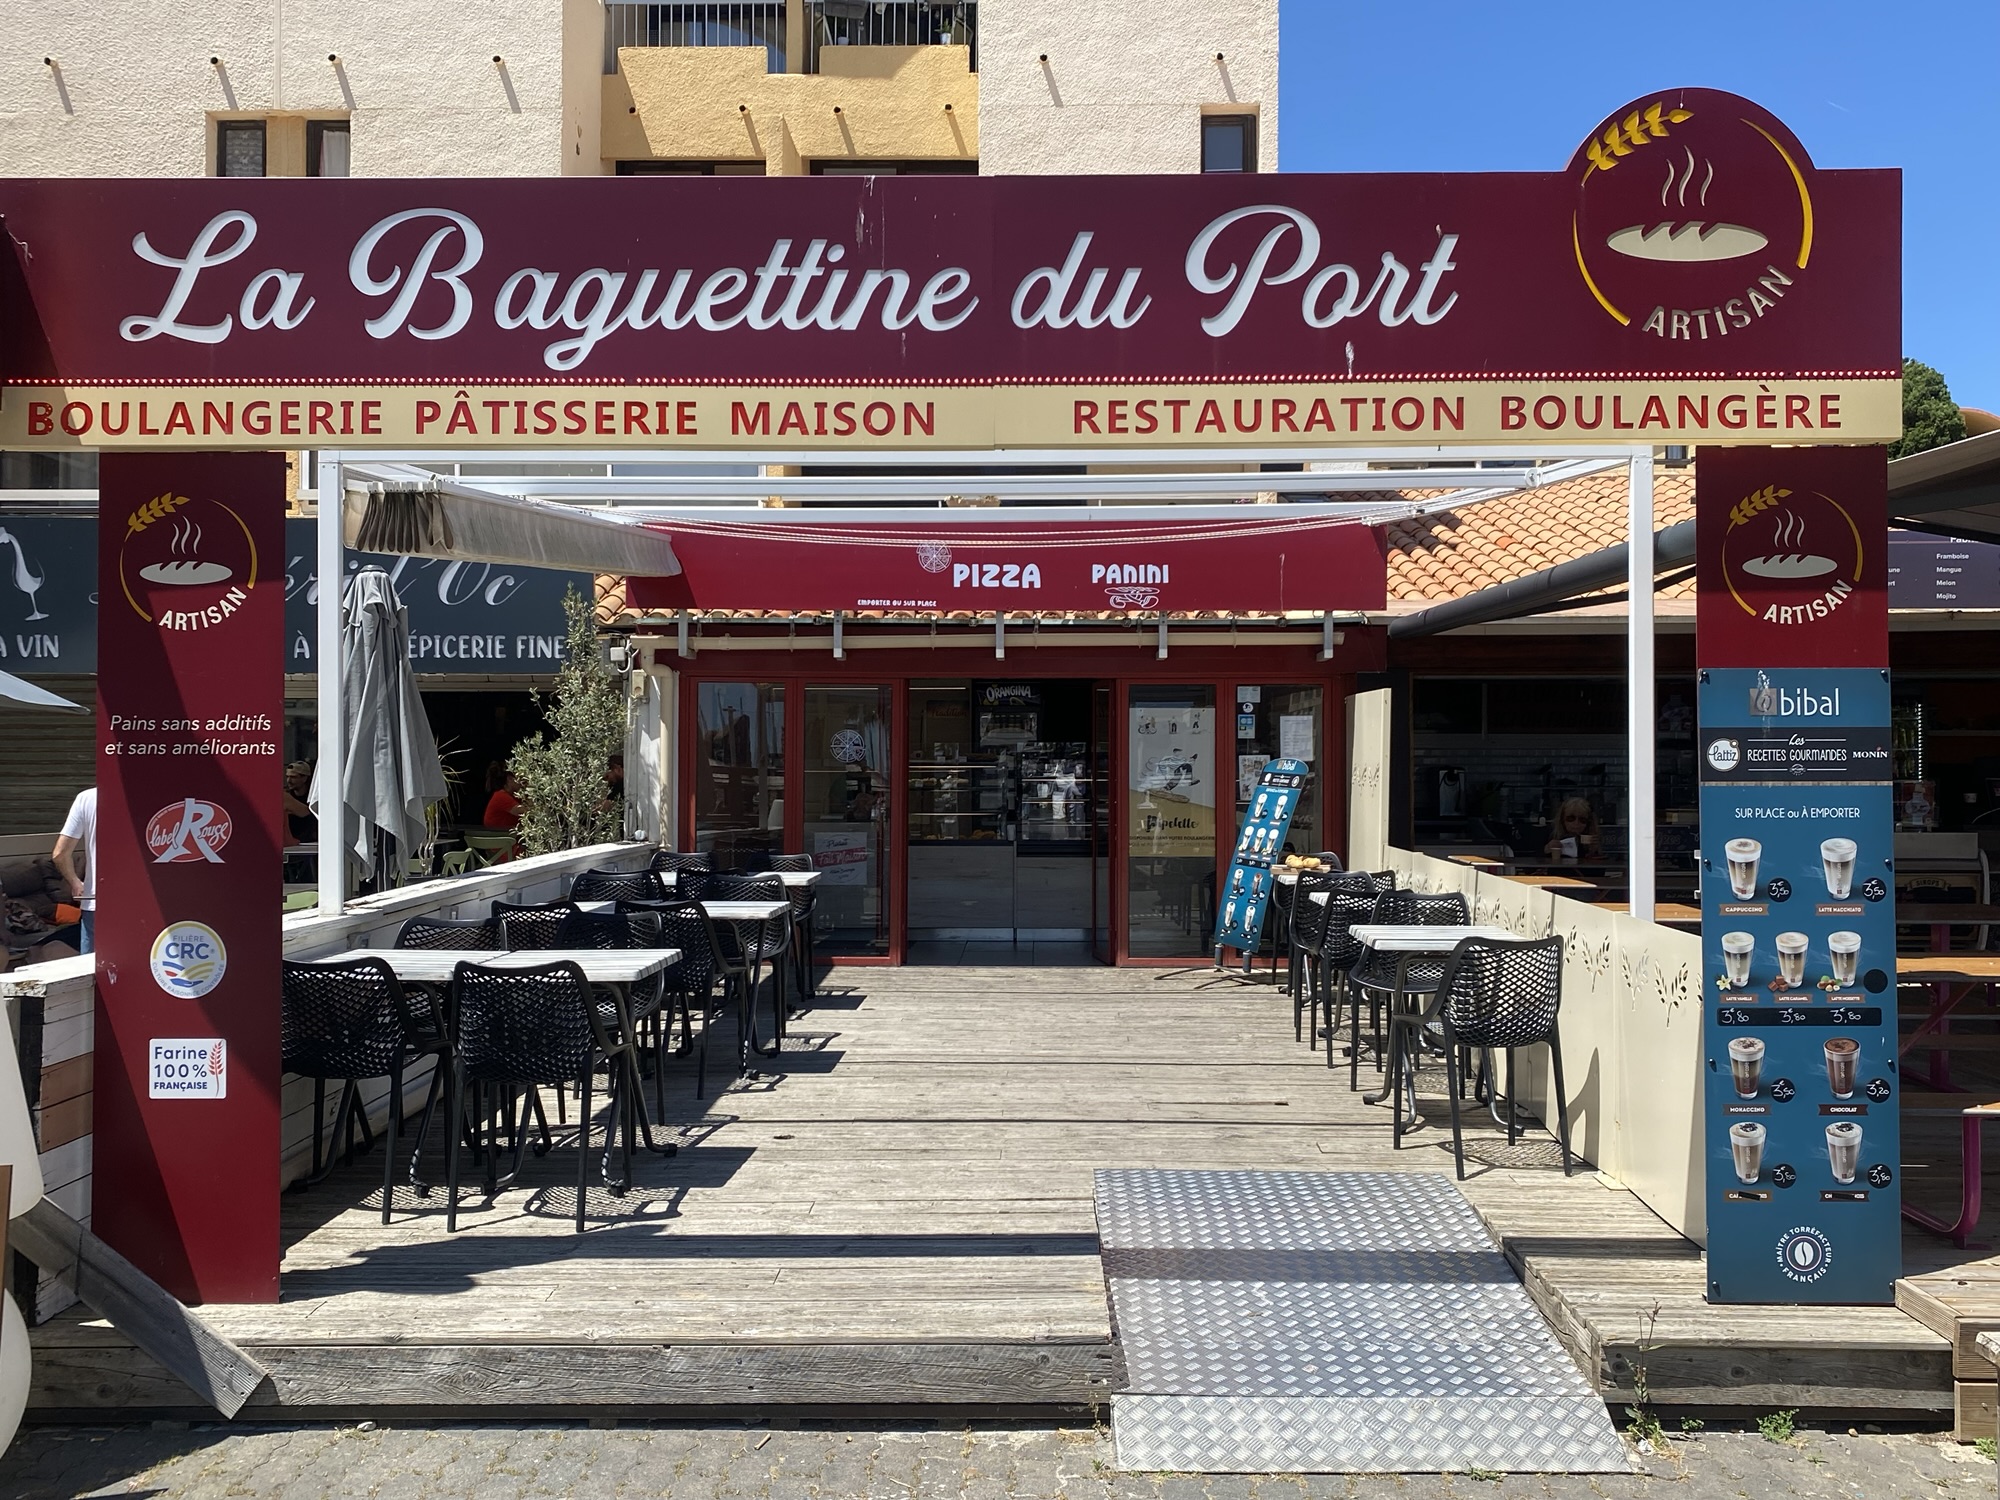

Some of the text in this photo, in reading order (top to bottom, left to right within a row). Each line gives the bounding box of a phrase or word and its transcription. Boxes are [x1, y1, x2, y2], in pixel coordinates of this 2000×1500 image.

[119, 204, 1458, 372] La Baguettine du Port
[1641, 264, 1794, 340] ARTISAN
[27, 390, 936, 437] BOULANGERIE PÂTISSERIE MAISON
[1073, 385, 1843, 436] RESTAURATION BOULANGÈRE
[953, 563, 1042, 589] PIZZA
[1091, 563, 1169, 584] PANINI
[158, 585, 248, 632] ARTISAN
[903, 599, 916, 607] SUR
[1763, 578, 1853, 625] ARTISAN
[16, 634, 59, 658] VIN
[293, 629, 310, 659] À
[408, 629, 566, 659] ÉPICERIE FINE
[986, 685, 1032, 702] ORANGINA
[1779, 687, 1840, 716] bibal
[110, 714, 271, 731] Pains sans additifs
[105, 739, 276, 756] et sans améliorants
[1788, 733, 1806, 746] Les
[1747, 748, 1847, 762] RECETTES GOURMANDES
[1734, 805, 1861, 819] SUR PLACE ou À EMPORTER
[150, 821, 180, 850] label
[172, 934, 205, 943] FILIÈRE
[165, 942, 210, 960] CRC
[155, 1046, 208, 1060] Farine
[154, 1081, 208, 1093] FRANÇAISE
[1789, 1226, 1833, 1263] TORRÉFACTEUR
[1782, 1267, 1827, 1284] FRANÇAIS
